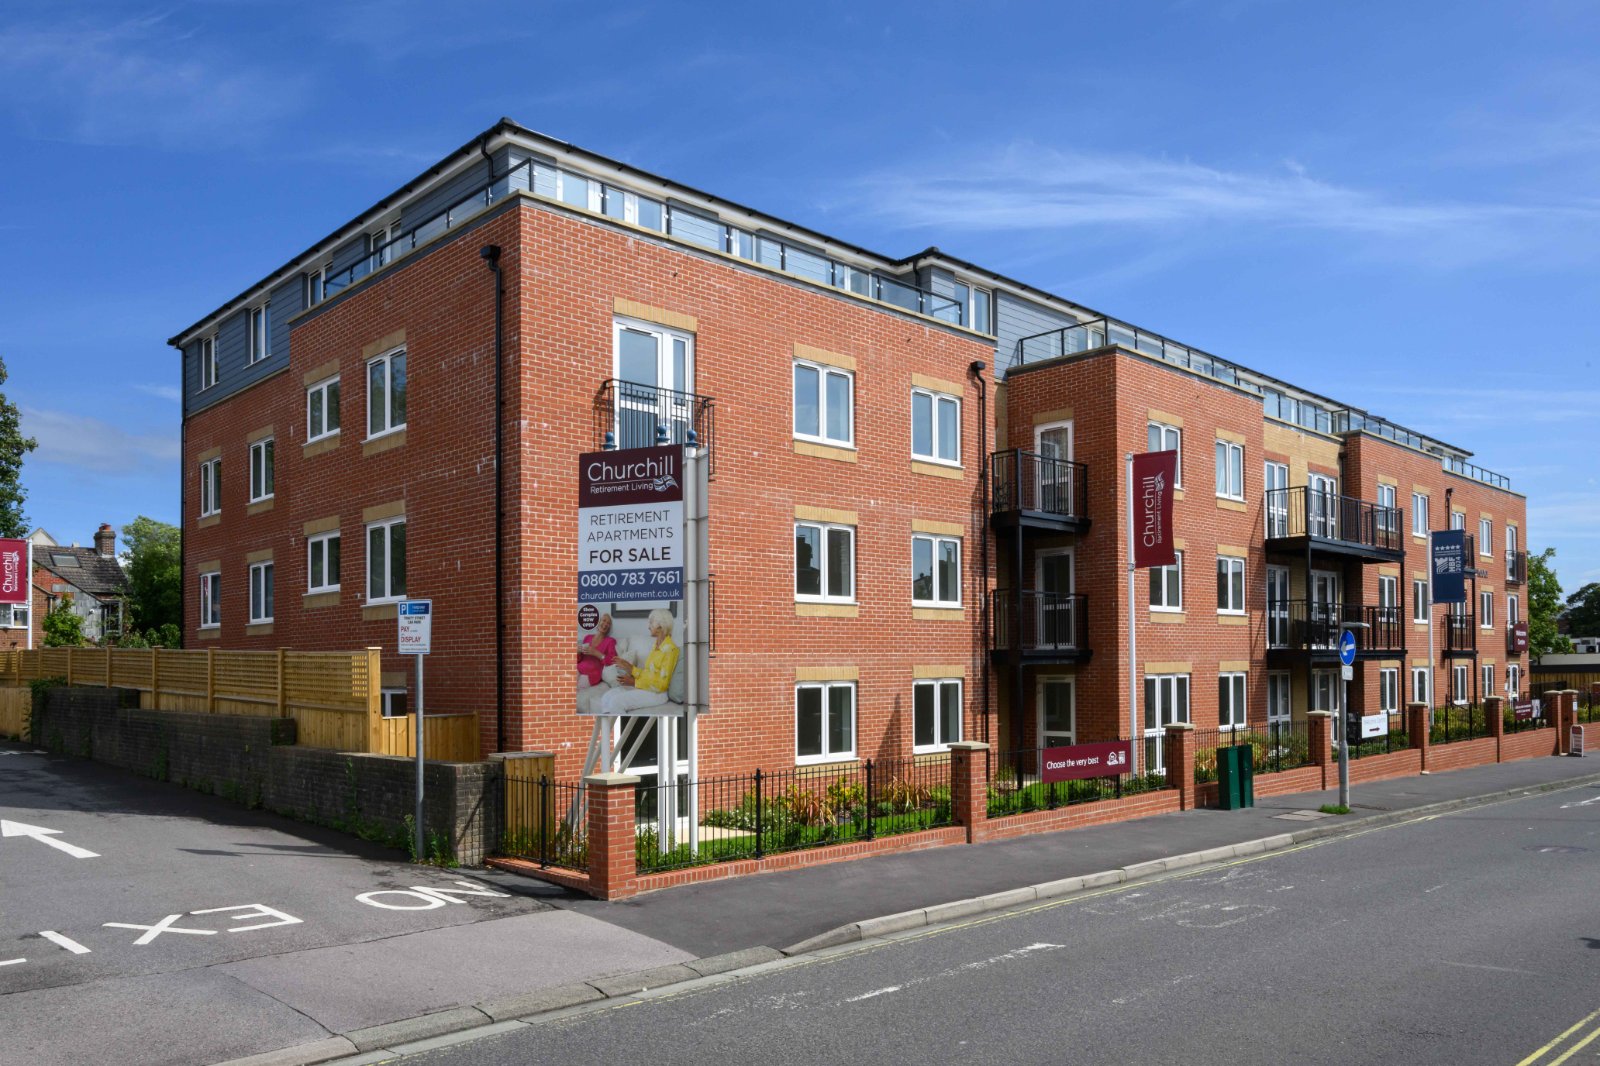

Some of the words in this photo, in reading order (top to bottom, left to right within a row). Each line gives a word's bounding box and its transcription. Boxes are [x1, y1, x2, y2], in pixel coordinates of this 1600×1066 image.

[587, 455, 673, 482] Churchill
[590, 483, 630, 494] Retirement
[631, 482, 654, 492] Living
[590, 509, 671, 526] RETIREMENT
[1142, 476, 1155, 547] Churchill
[587, 527, 674, 543] APARTMENTS
[589, 549, 623, 564] FOR
[628, 546, 671, 562] SALE
[2, 551, 13, 593] Churchill
[580, 573, 617, 587] 0800
[621, 571, 646, 585] 783
[649, 570, 680, 584] 7661
[580, 588, 680, 600] churchillretirement.co.uk
[1046, 761, 1066, 770] Choose
[1066, 759, 1075, 767] the
[1076, 759, 1087, 767] very
[1087, 756, 1099, 765] best
[0, 904, 304, 966] EXI
